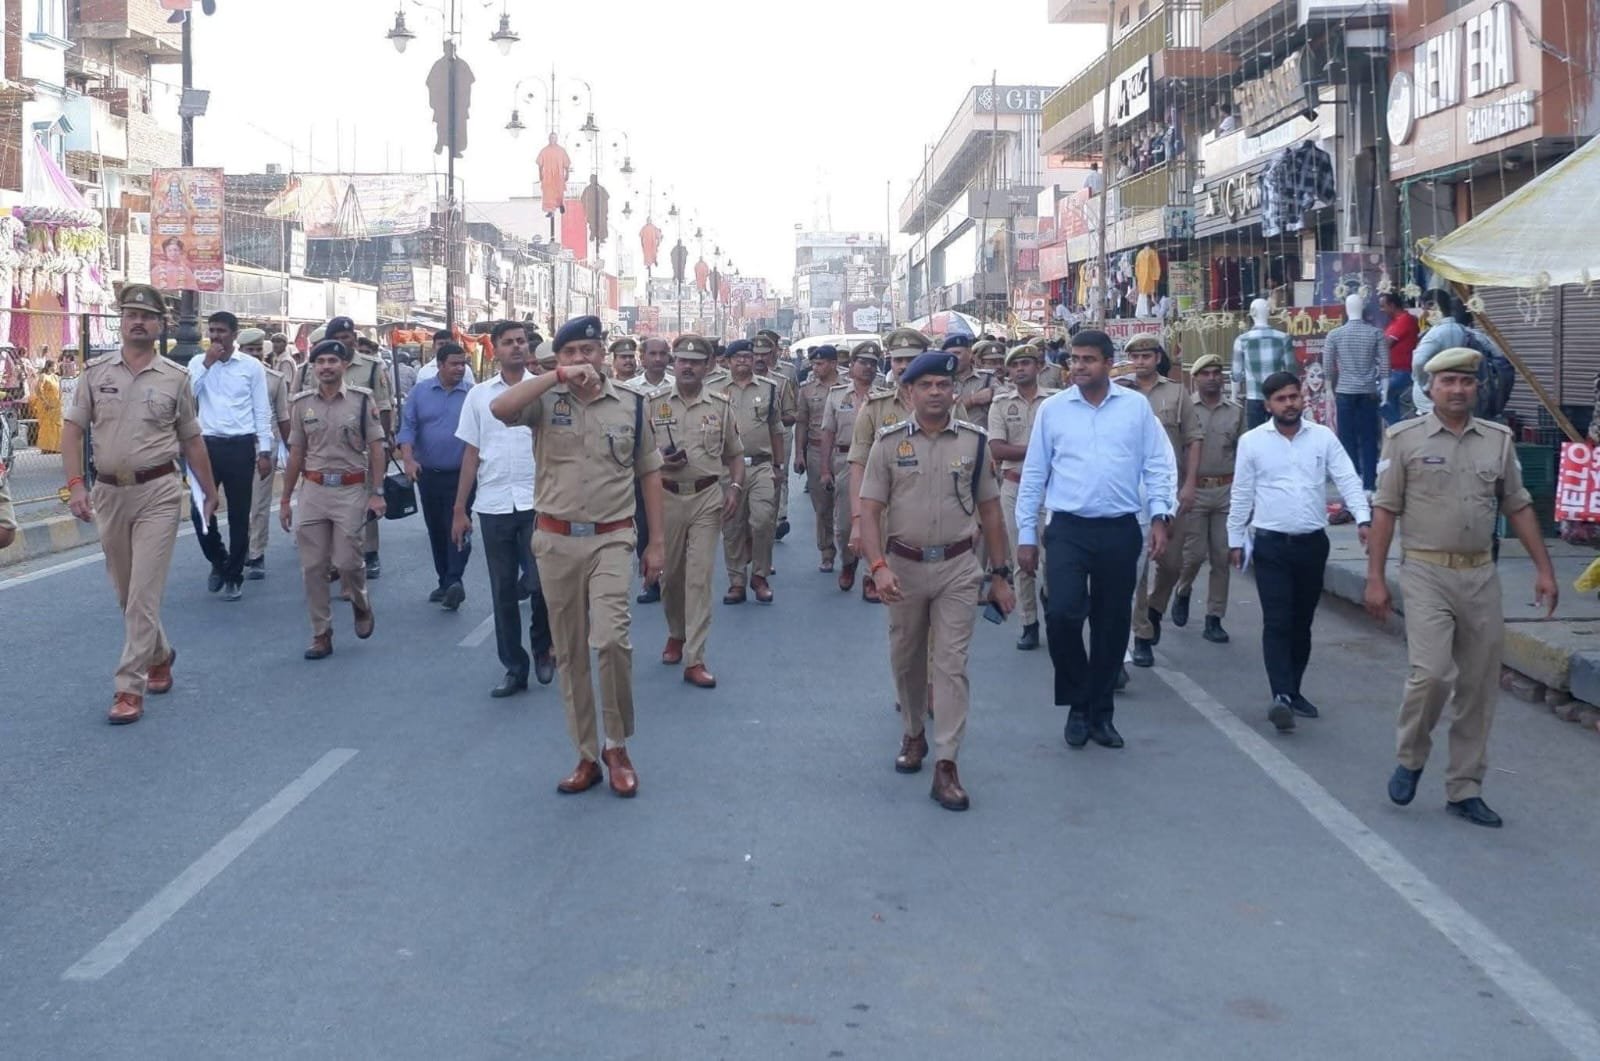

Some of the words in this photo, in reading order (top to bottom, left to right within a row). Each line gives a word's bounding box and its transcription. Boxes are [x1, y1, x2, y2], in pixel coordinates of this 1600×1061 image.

[1414, 27, 1462, 119] NEW
[1466, 2, 1514, 98] ERA
[1467, 90, 1536, 144] GARMENTS
[1559, 443, 1591, 520] HELLO
